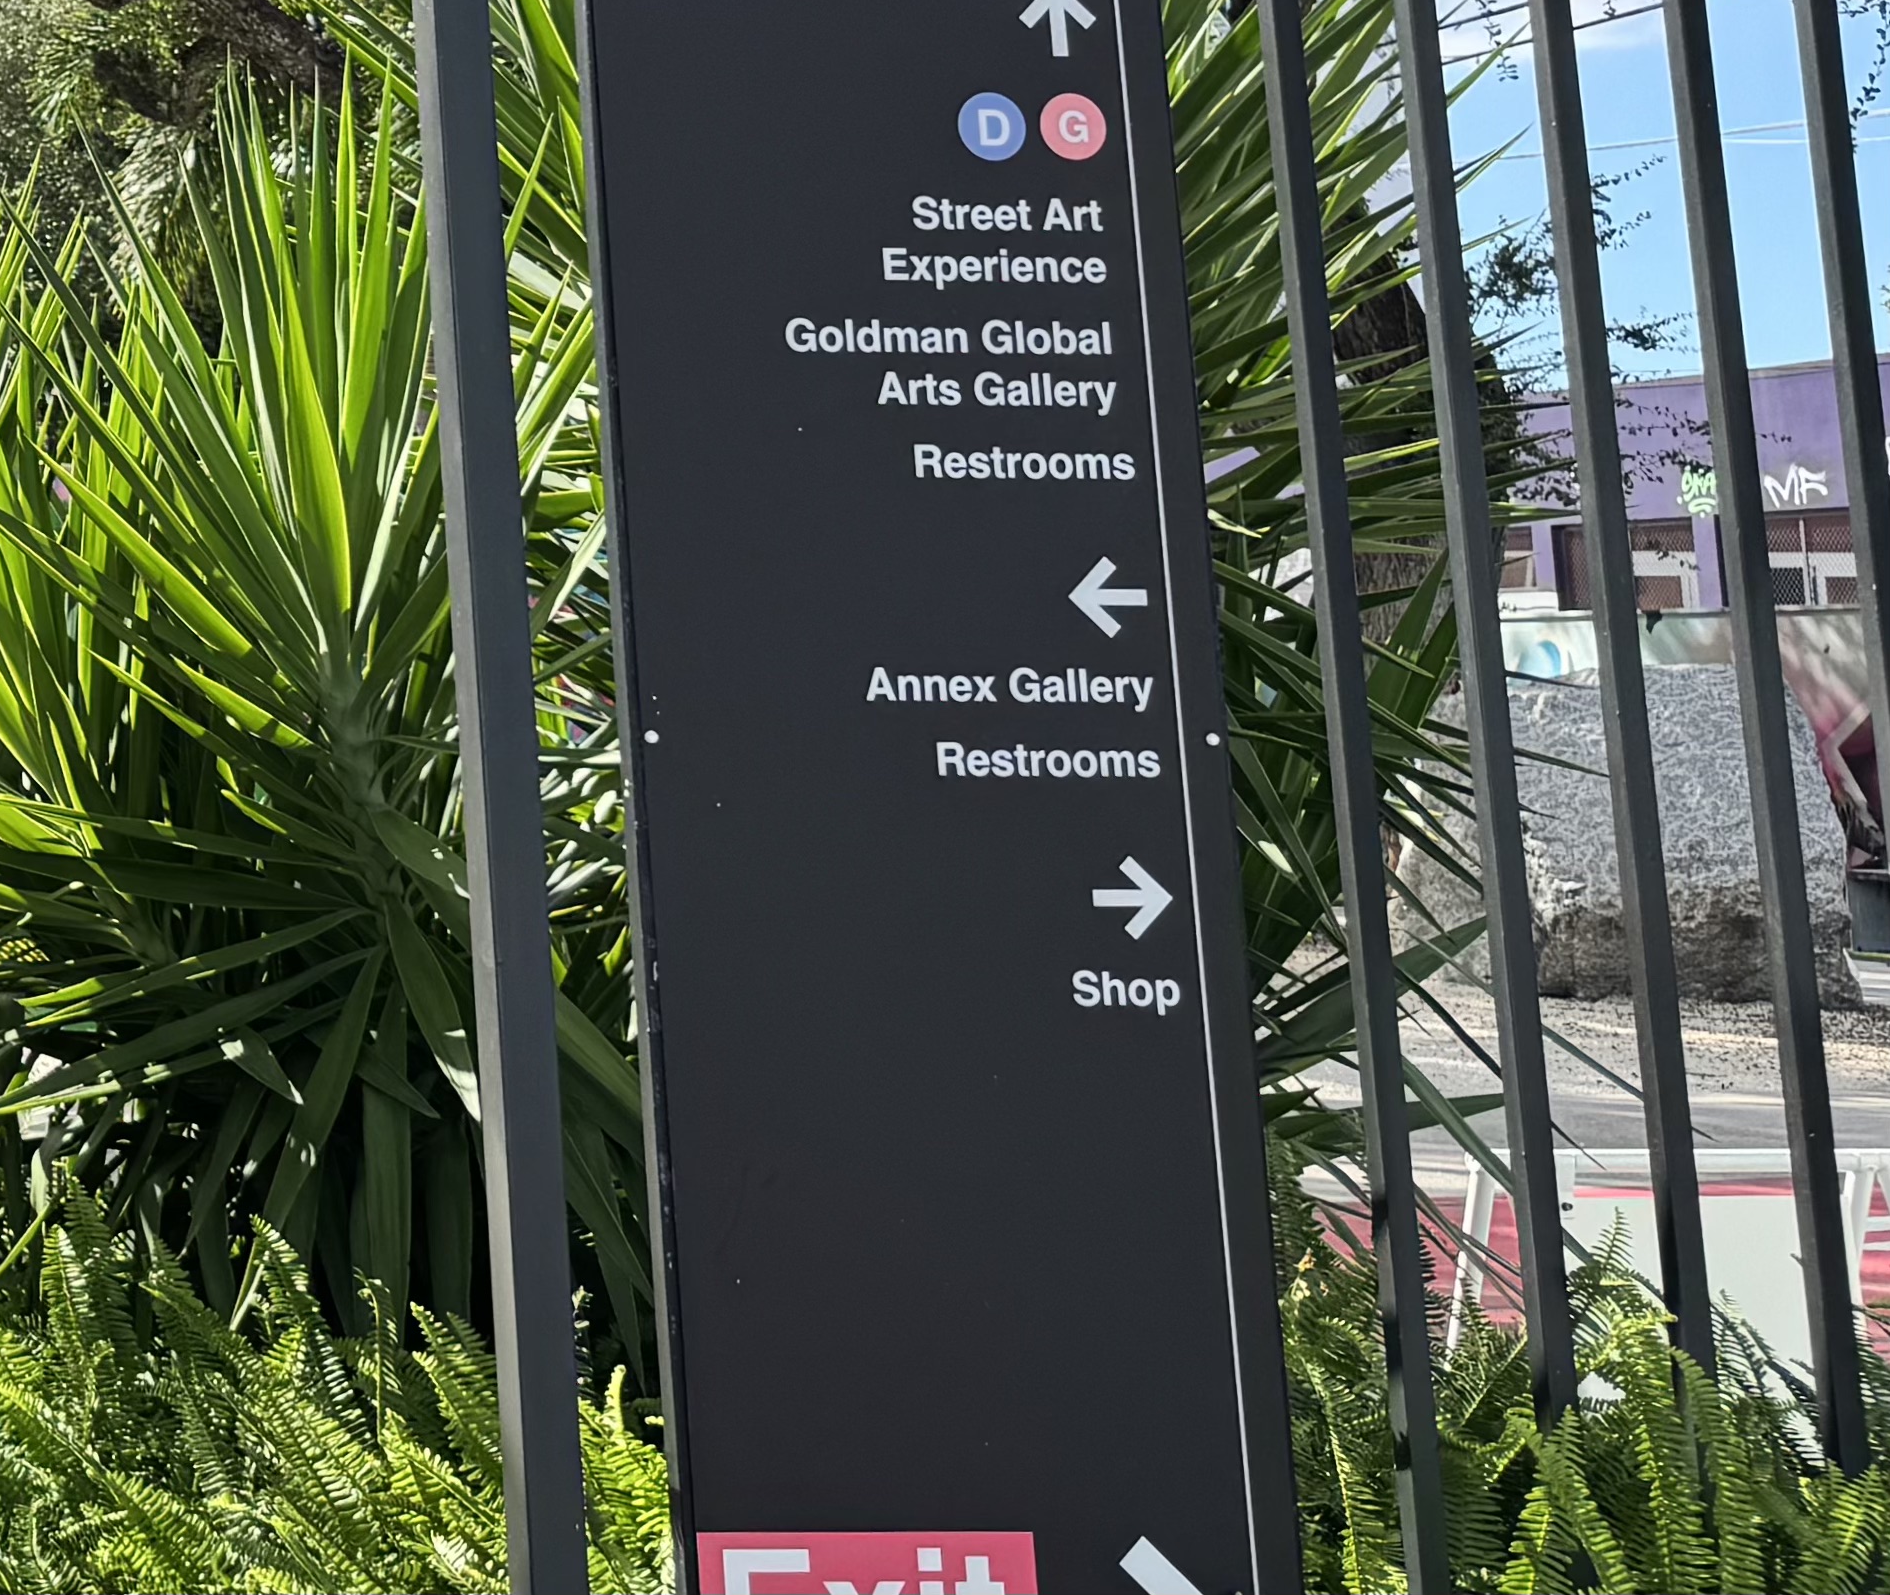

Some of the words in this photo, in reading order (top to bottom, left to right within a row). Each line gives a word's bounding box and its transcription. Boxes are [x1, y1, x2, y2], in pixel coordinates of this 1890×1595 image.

[977, 108, 1012, 147] D
[1058, 110, 1089, 143] G
[912, 195, 1033, 232] Street
[1043, 198, 1104, 233] Art
[881, 247, 1108, 290] Experience
[784, 317, 970, 355] Goldman
[980, 319, 1112, 356] Global
[877, 371, 962, 407] Arts
[973, 371, 1117, 416] Gallery
[913, 443, 1136, 481] Restrooms
[866, 666, 998, 703] Annex
[1008, 667, 1155, 712] Gallery
[936, 741, 1162, 779] Restrooms
[1072, 968, 1182, 1016] Shop
